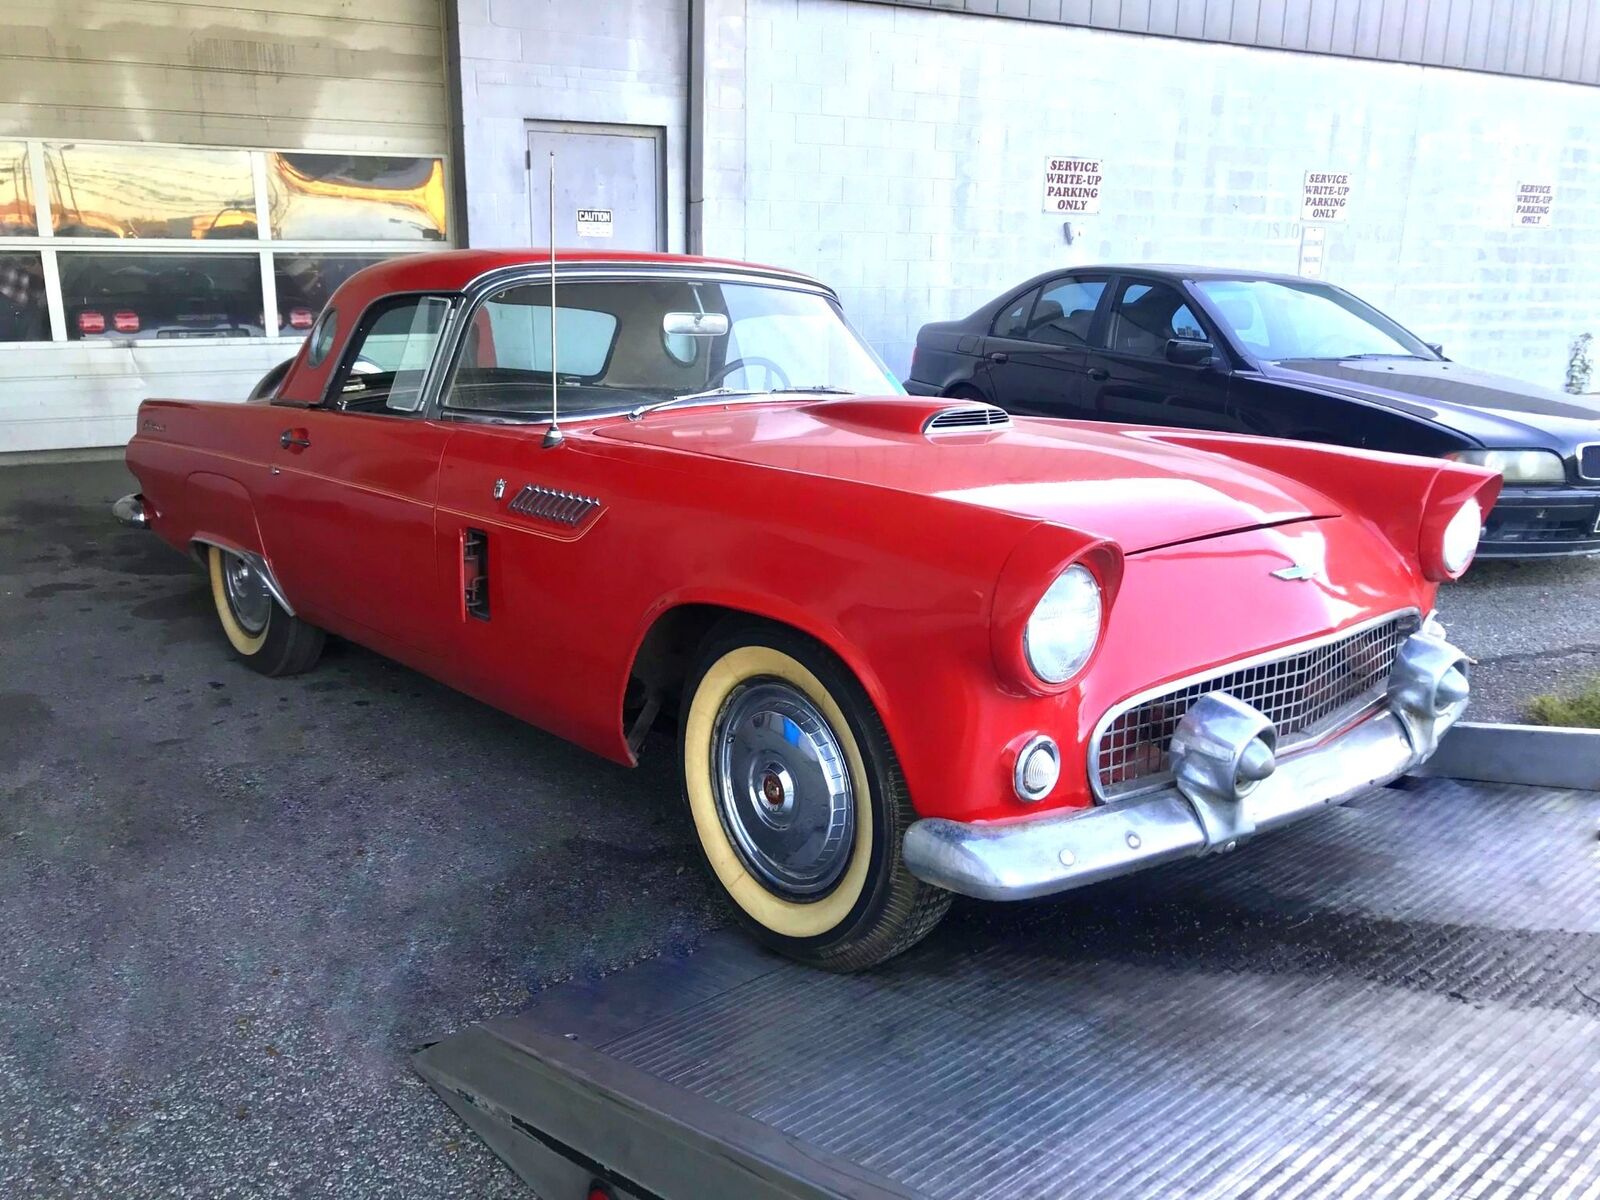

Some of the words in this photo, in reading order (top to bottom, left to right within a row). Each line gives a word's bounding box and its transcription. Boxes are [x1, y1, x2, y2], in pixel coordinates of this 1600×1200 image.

[1050, 160, 1099, 172] SERVICE
[1046, 173, 1102, 185] WRITE-UP
[1309, 173, 1348, 184] SERVICE
[1047, 186, 1098, 198] PARKING
[1305, 185, 1350, 196] WRITE-UP
[1520, 184, 1551, 194] SERVICE
[1057, 199, 1088, 210] ONLY
[1305, 197, 1346, 207] PARKING
[1312, 208, 1337, 218] ONLY
[1516, 205, 1549, 214] PARKING
[579, 211, 610, 221] CAUTION
[1521, 215, 1541, 224] ONLY
